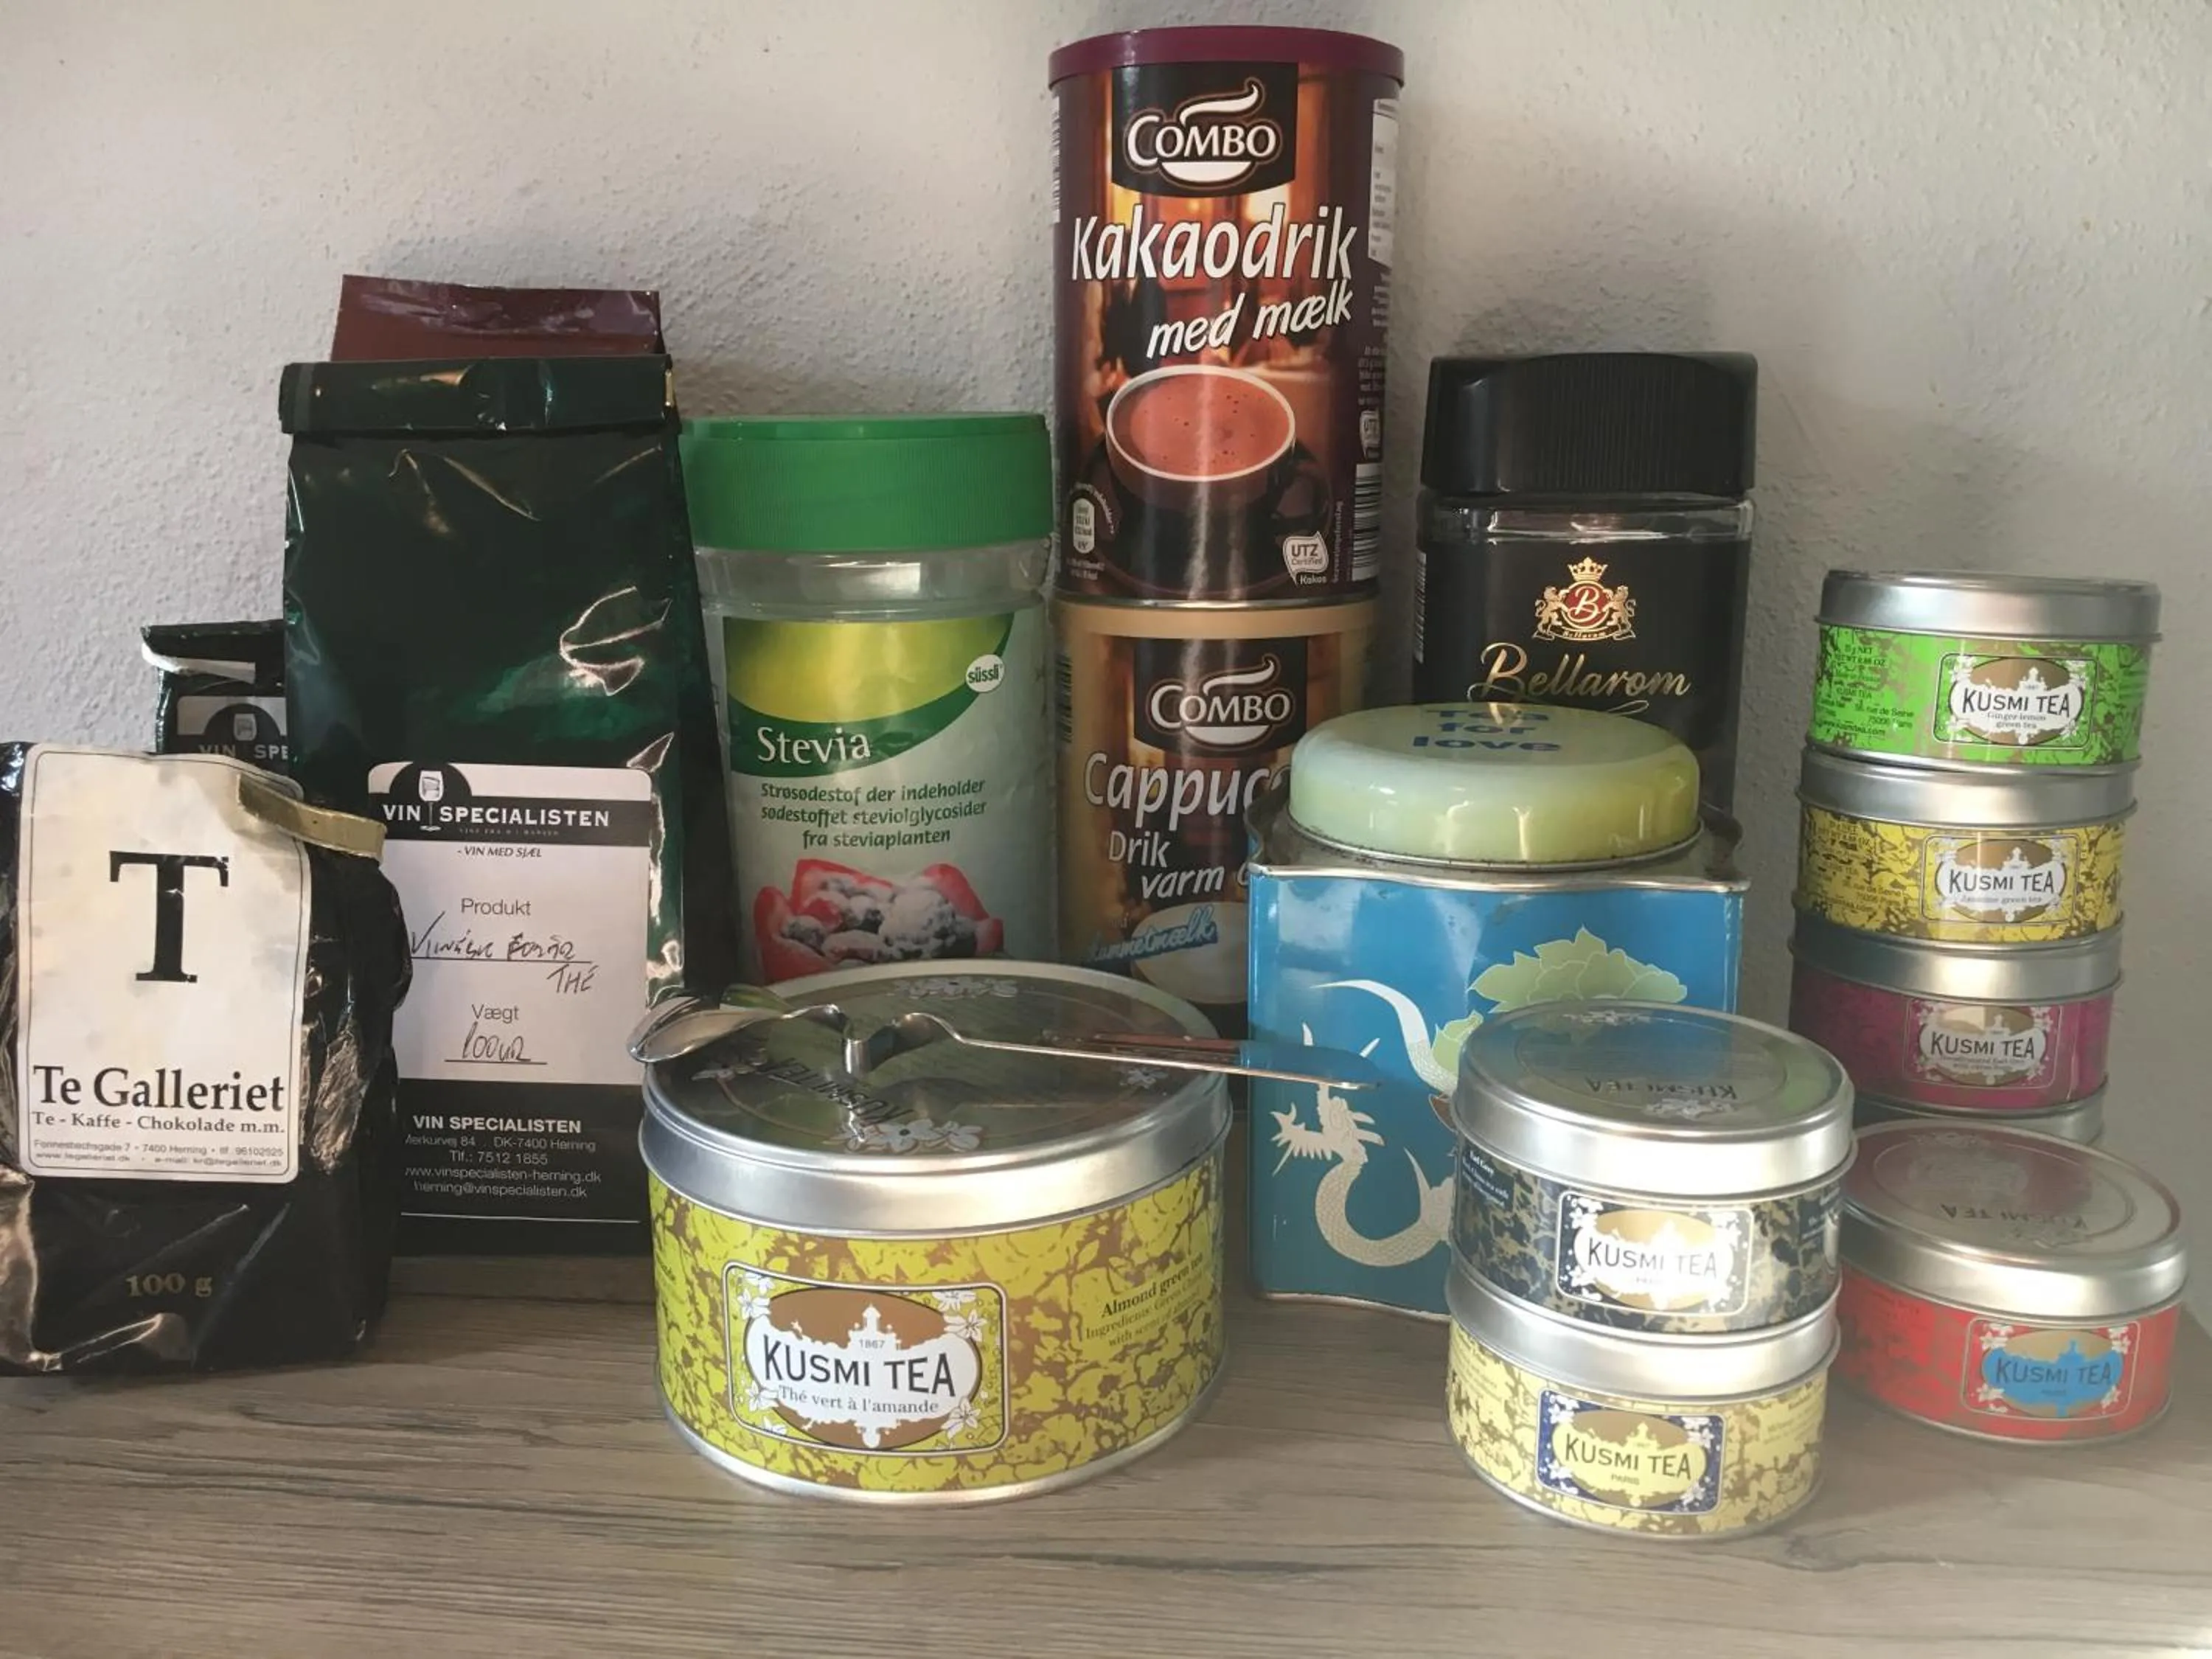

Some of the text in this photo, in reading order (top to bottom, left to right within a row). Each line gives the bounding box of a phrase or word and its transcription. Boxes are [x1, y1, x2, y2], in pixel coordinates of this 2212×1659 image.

[1127, 115, 1276, 167] COMBO
[1072, 204, 1357, 281] Kakaodrik
[1147, 292, 1245, 359] med
[1253, 278, 1354, 340] mælk
[1291, 543, 1319, 557] UTZ
[1291, 557, 1323, 566] Certified
[967, 664, 999, 684] süssli
[1467, 642, 1692, 702] Bellarom
[1151, 684, 1290, 728] COMBO
[1425, 709, 1550, 721] Tea
[1962, 687, 2070, 717] KUSMI TEA
[1439, 723, 1537, 734] for
[198, 744, 236, 757] VIN
[757, 726, 872, 765] Stevia
[1413, 736, 1561, 751] love
[761, 779, 986, 807] Strøsødestof der indeholder
[383, 804, 609, 827] VIN SPECIALISTEN
[761, 801, 987, 829] sødestoffet steviolglycosider
[465, 846, 485, 855] VIN
[489, 847, 514, 857] MED
[516, 847, 542, 858] SJÆL
[802, 829, 951, 850] fra steviaplanten
[1110, 830, 1170, 868] Drik
[1141, 864, 1225, 900] varm
[1949, 869, 2054, 894] KUSMI TEA
[110, 851, 229, 983] T
[461, 897, 531, 917] Produkt
[472, 1004, 519, 1023] Vægt
[1930, 1032, 2035, 1060] KUSMI TEA
[33, 1065, 285, 1111] Te Galleriet
[32, 1112, 55, 1125] Te
[72, 1113, 121, 1129] Kaffe
[137, 1116, 235, 1133] Chokolade
[240, 1122, 285, 1133] m.m.
[413, 1115, 582, 1133] VIN SPECIALISTEN
[143, 1144, 167, 1153] 7400
[460, 1135, 476, 1147] 84
[494, 1136, 547, 1150] DK-7400
[516, 1152, 548, 1166] 1855
[1588, 1237, 1717, 1279] KUSMI TEA
[126, 1273, 213, 1298] 100 g
[1102, 1281, 1157, 1318] Almond
[1160, 1265, 1190, 1295] green
[859, 1338, 886, 1350] 1867
[763, 1335, 956, 1397] KUSMI TEA
[1996, 1357, 2111, 1385] KUSMI TEA
[779, 1384, 940, 1414] Thé vert à l'amande
[1565, 1433, 1691, 1481] KUSMI TEA
